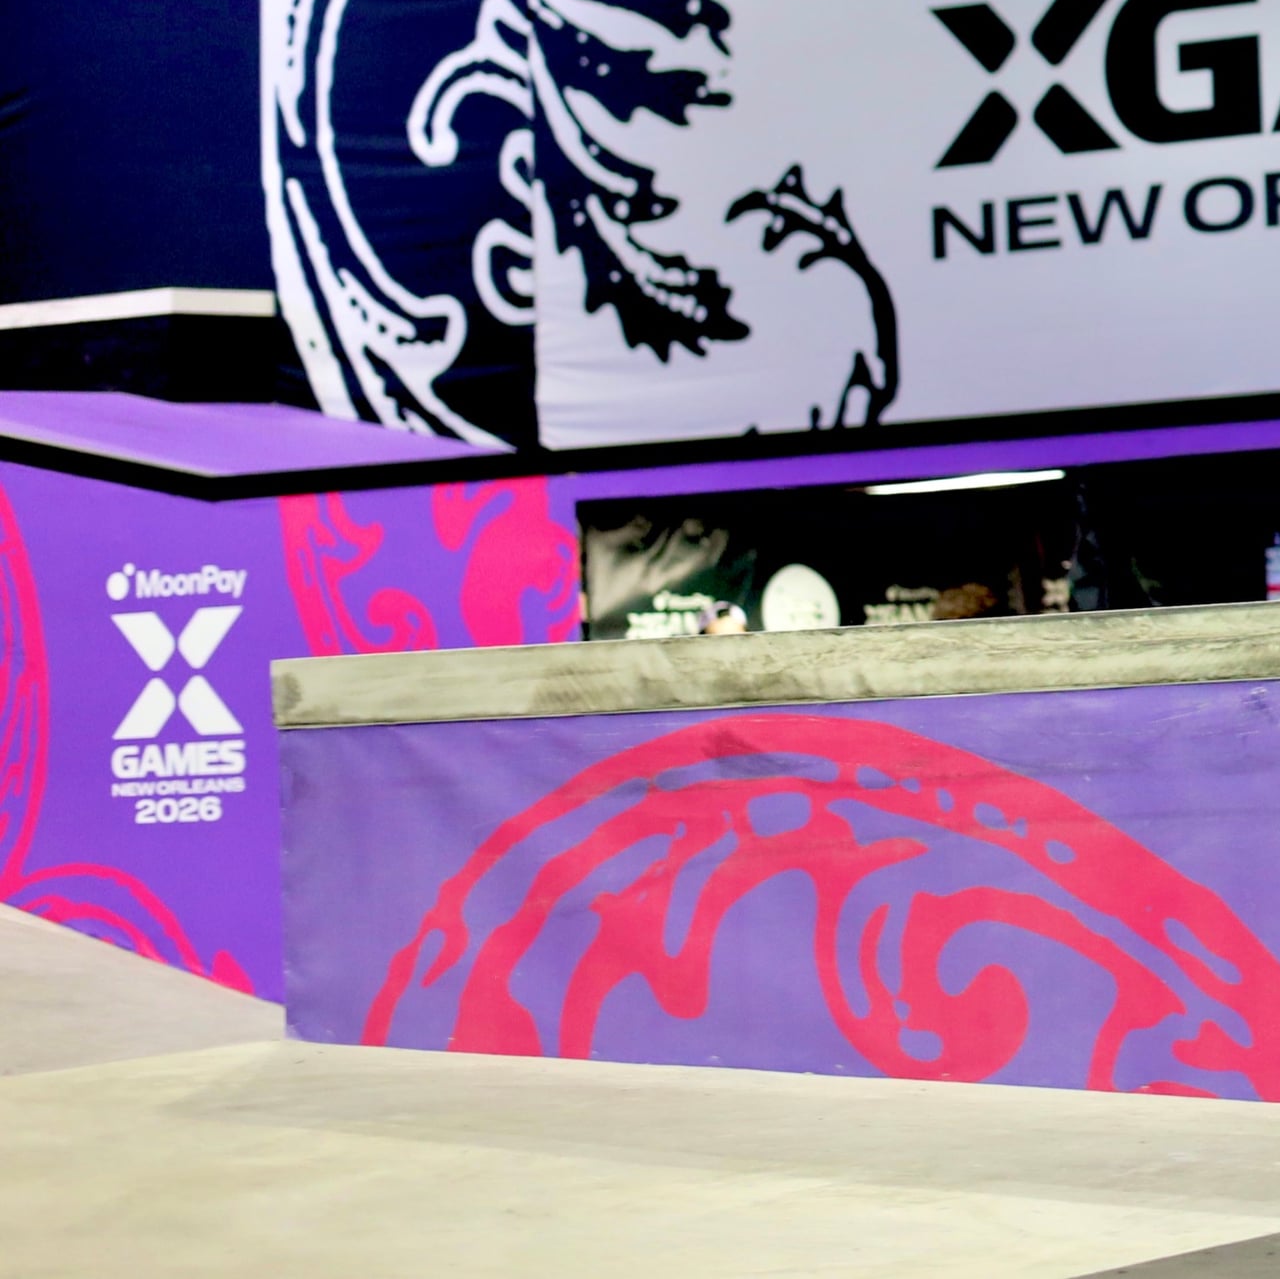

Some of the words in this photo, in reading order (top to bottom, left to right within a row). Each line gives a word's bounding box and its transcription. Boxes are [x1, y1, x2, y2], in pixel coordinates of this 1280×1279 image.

[931, 184, 1163, 261] NEW
[136, 565, 247, 599] MoonPay
[111, 740, 246, 780] GAMES
[111, 780, 156, 798] NEW
[156, 776, 246, 796] ORLEANS
[134, 796, 222, 824] 2026
